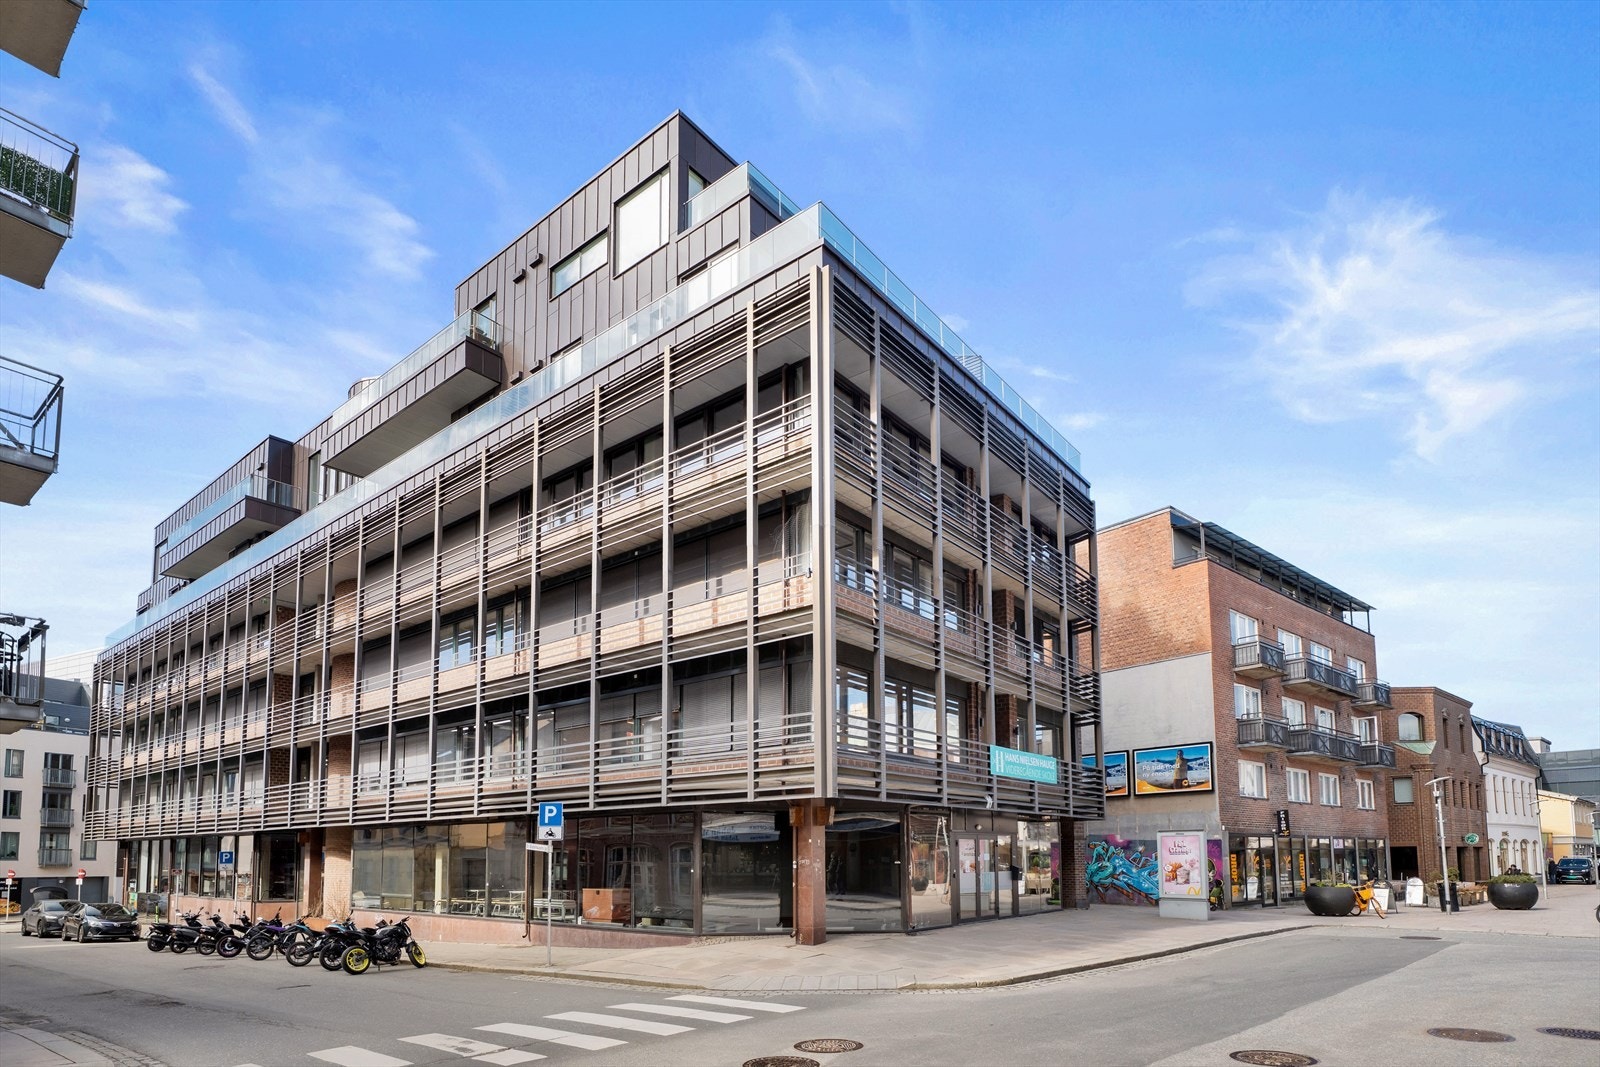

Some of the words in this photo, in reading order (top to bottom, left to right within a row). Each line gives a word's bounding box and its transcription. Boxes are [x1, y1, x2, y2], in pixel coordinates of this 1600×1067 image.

[1004, 752, 1019, 763] HANS
[1020, 755, 1039, 767] NIELSEN
[1039, 759, 1055, 770] HAUGE
[544, 805, 557, 824] P
[222, 852, 231, 863] P
